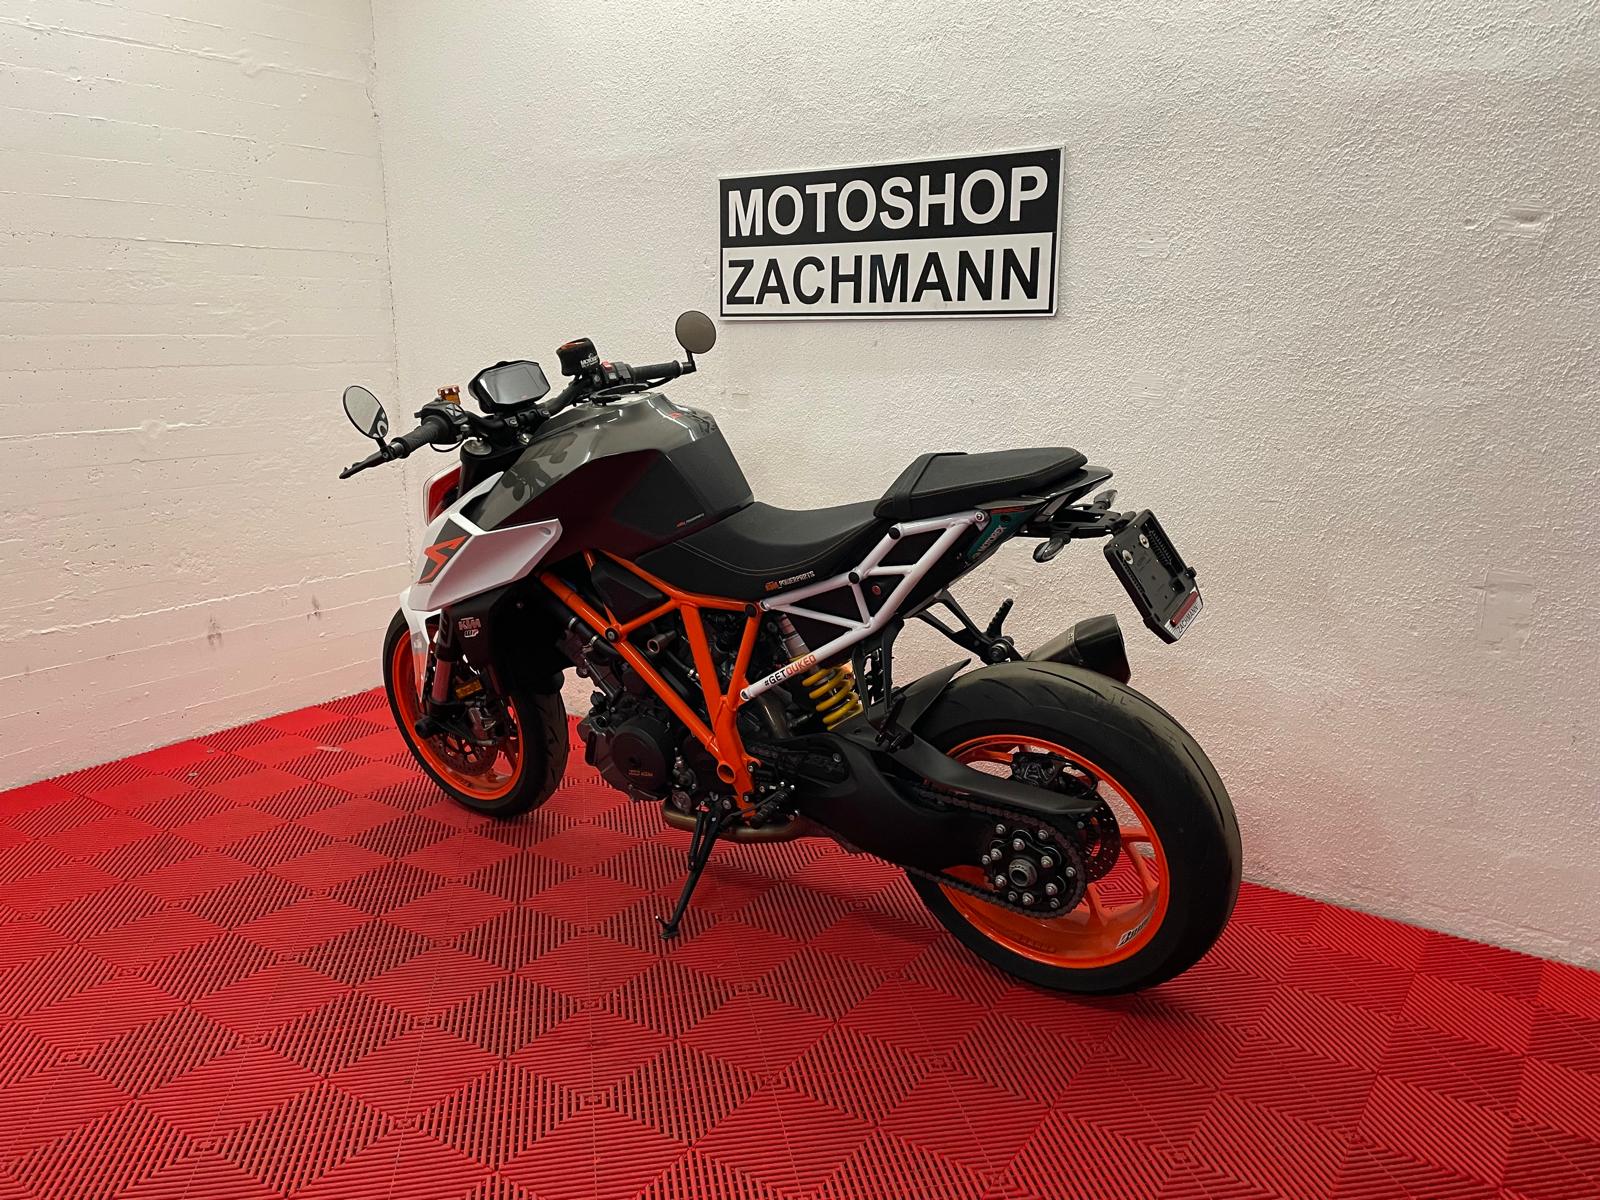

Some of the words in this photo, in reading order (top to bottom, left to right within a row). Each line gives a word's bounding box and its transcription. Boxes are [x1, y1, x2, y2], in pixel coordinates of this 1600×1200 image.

[728, 165, 1049, 238] MOTOSHOP
[726, 247, 1041, 305] ZACHMANN
[458, 617, 481, 630] KTM
